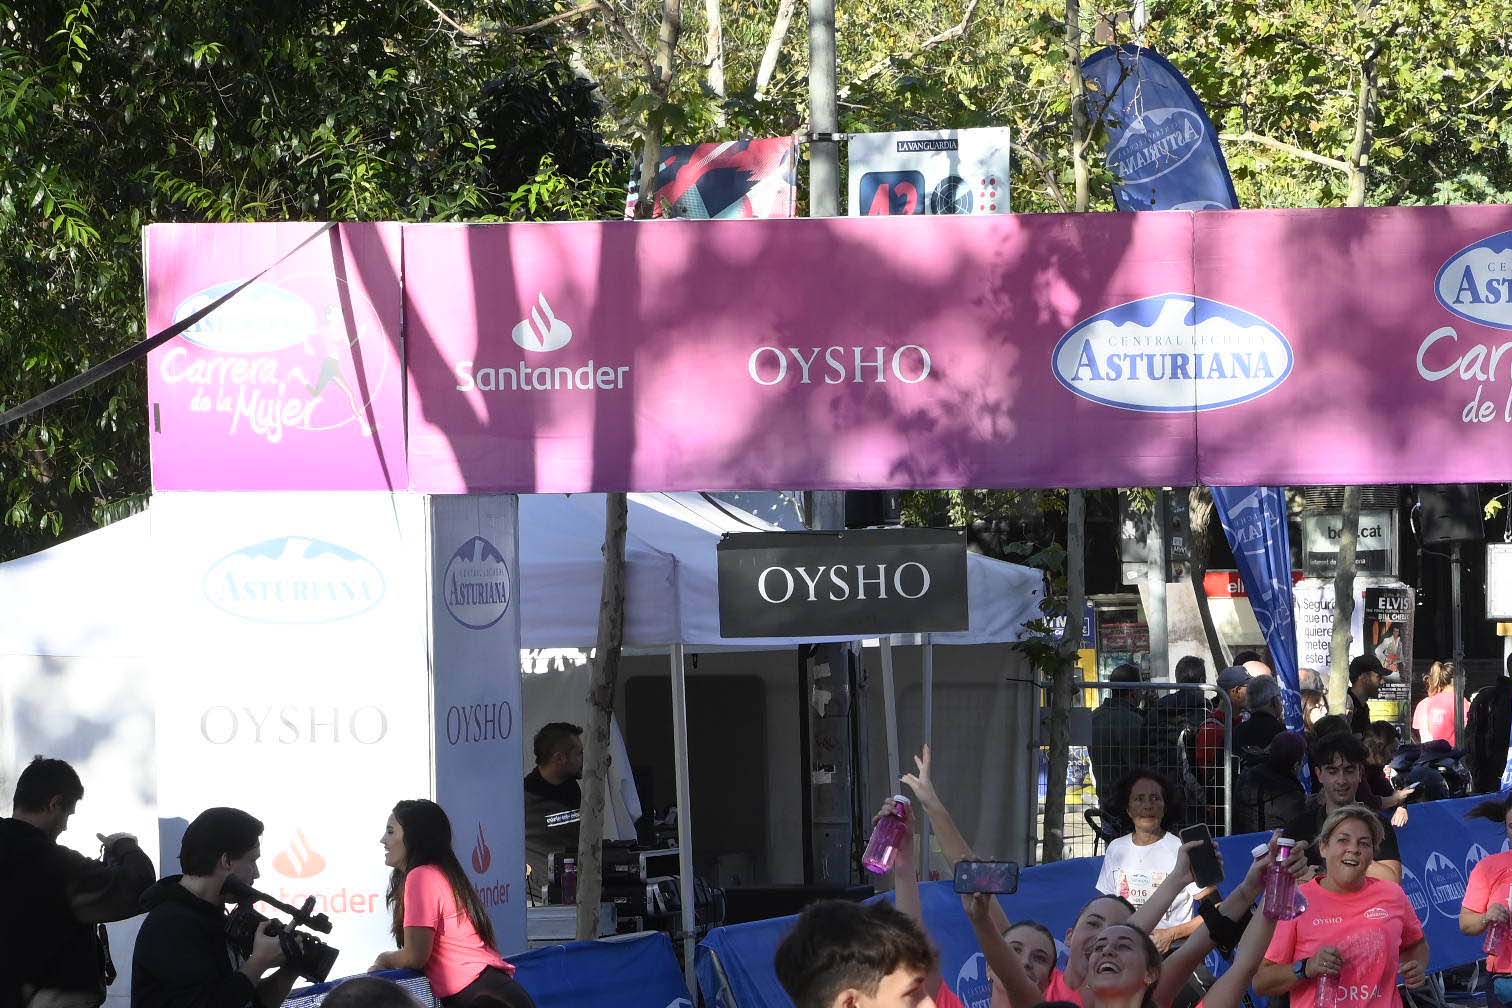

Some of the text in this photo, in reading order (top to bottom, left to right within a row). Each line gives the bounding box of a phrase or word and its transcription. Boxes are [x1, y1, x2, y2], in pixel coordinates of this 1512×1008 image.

[1071, 338, 1274, 383] ASTURIANA
[1107, 334, 1267, 348] CENTRAL LECHERA
[160, 346, 279, 387] Carrera
[456, 361, 629, 393] Santander
[748, 345, 932, 385] OYSHO
[229, 380, 323, 443] Mujer
[1463, 384, 1494, 423] de
[220, 570, 374, 601] ASTURIANA
[450, 580, 507, 606] ASTURIANA
[758, 562, 931, 603] OYSHO
[1378, 597, 1409, 609] ELVIS
[200, 705, 388, 745] OYSHO
[447, 701, 512, 746] OYSHO
